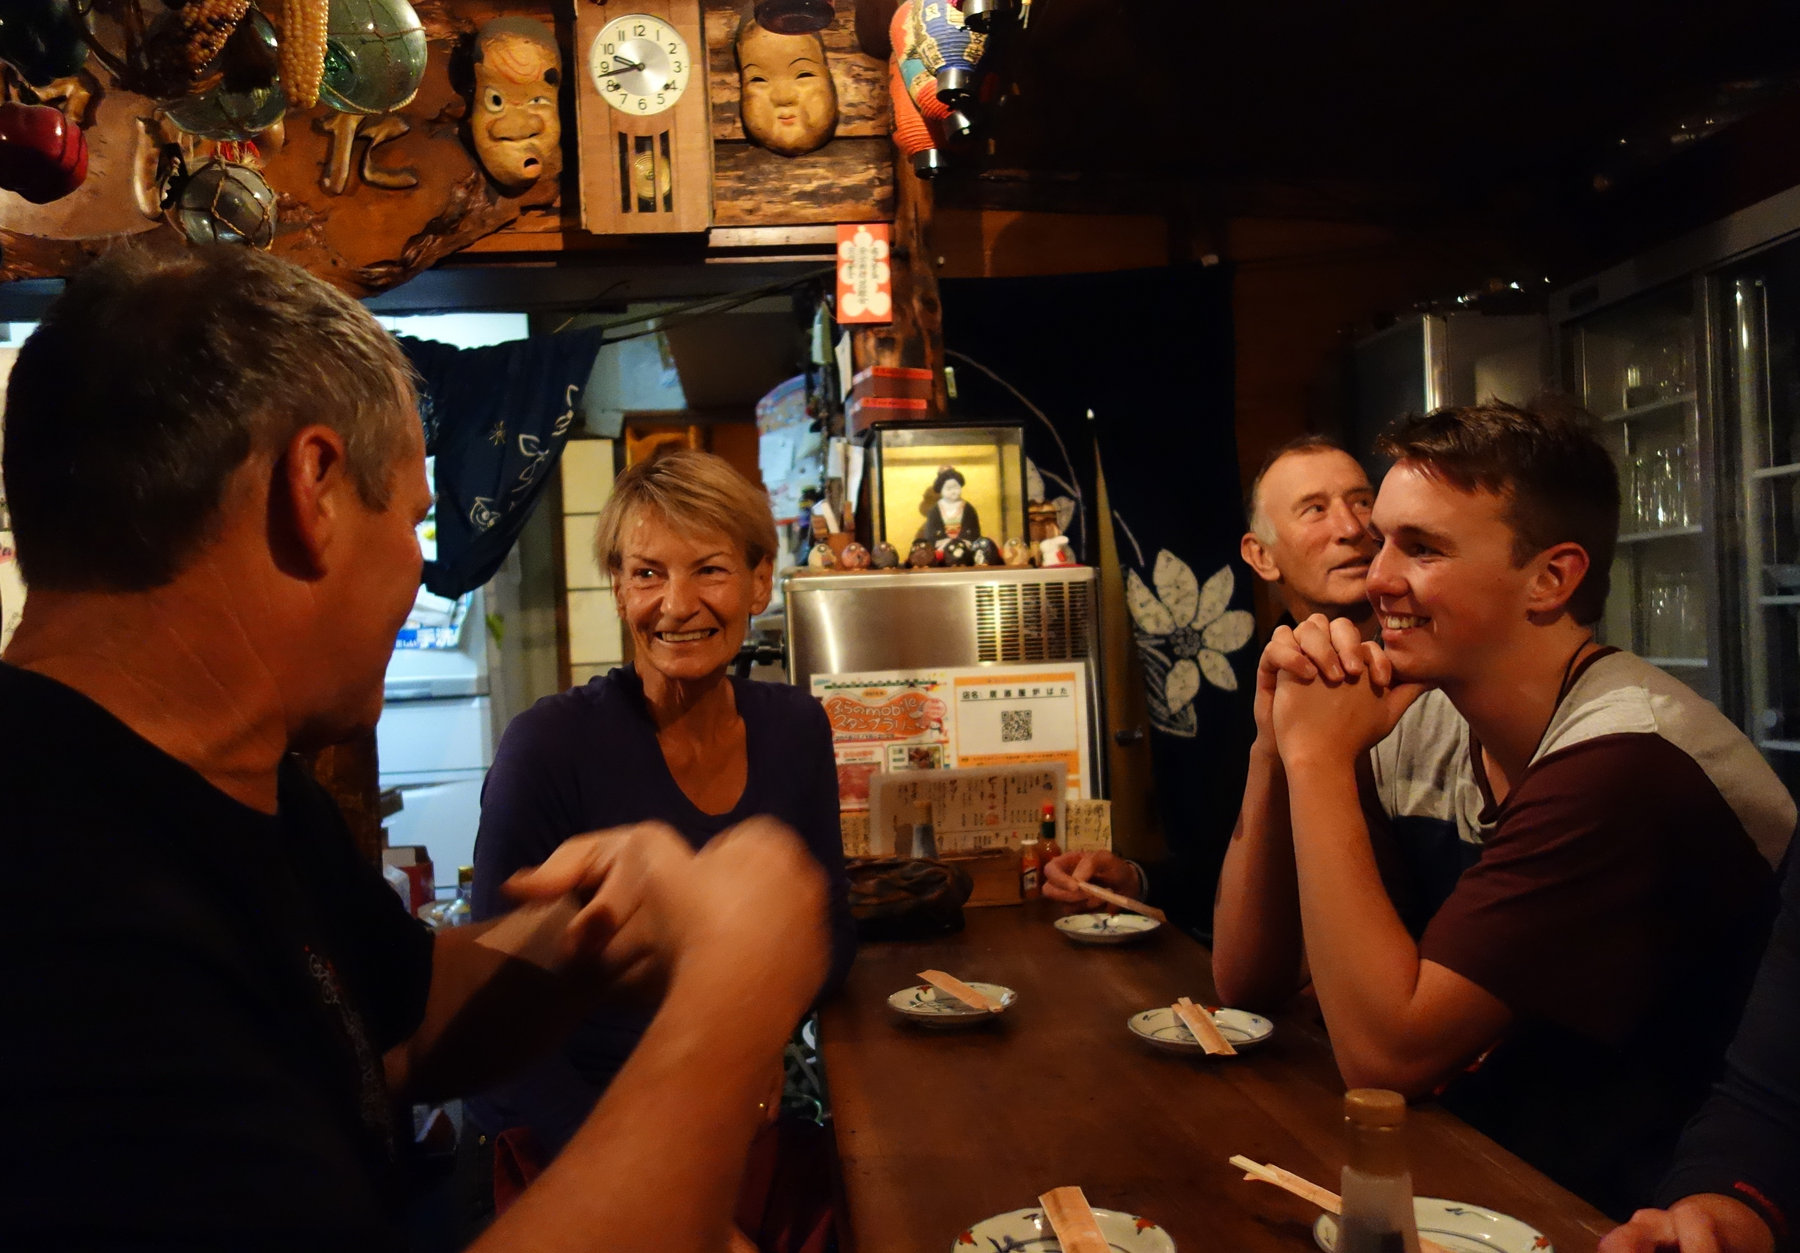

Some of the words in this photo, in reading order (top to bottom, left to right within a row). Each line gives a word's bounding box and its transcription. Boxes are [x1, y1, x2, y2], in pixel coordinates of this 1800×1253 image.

[618, 30, 625, 42] 11
[633, 25, 646, 37] 12
[603, 43, 615, 55] 10
[668, 42, 677, 54] 2
[600, 61, 609, 73] 9
[674, 61, 682, 73] 3
[606, 79, 616, 92] 8
[669, 79, 678, 91] 4
[620, 93, 628, 105] 7
[638, 98, 647, 110] 6
[657, 93, 665, 105] 5
